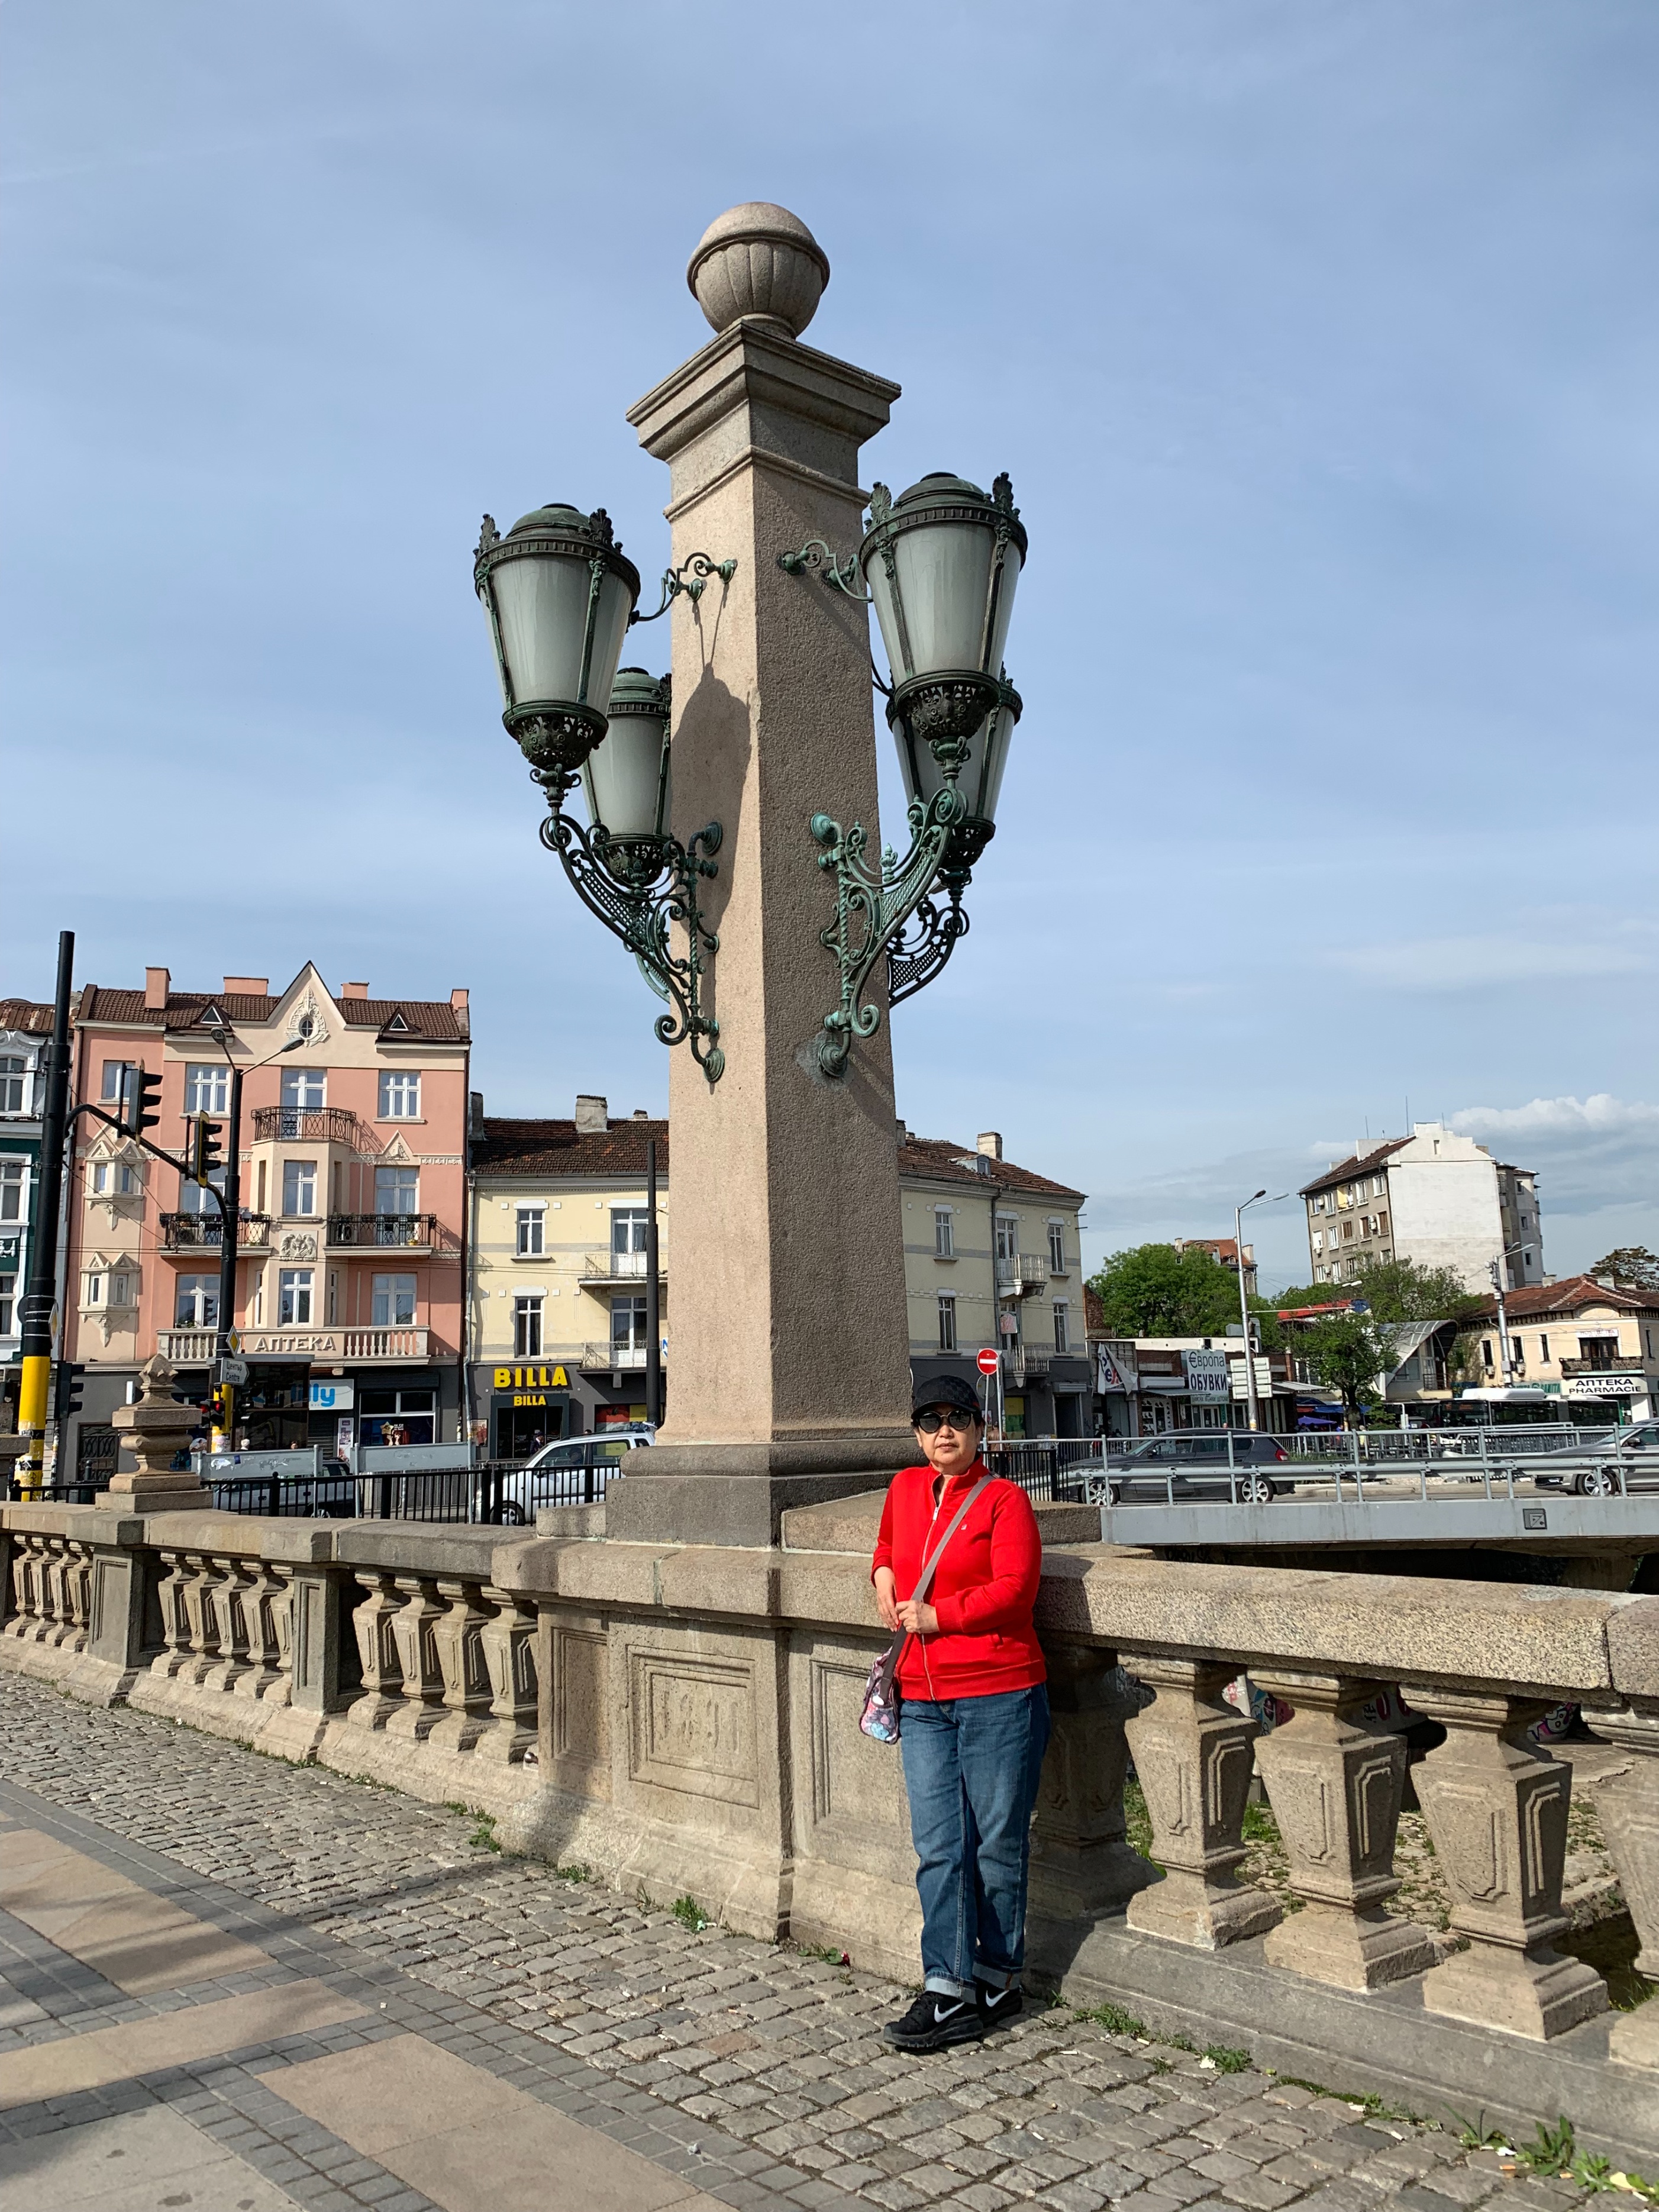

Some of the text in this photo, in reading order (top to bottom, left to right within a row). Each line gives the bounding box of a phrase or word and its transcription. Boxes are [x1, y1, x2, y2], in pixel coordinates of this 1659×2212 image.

[254, 1336, 336, 1352] АПТЕКА
[227, 1360, 243, 1373] Център
[226, 1372, 240, 1382] Centre
[493, 1366, 568, 1388] BILLA
[1190, 1373, 1228, 1391] ОБУВКИ
[1576, 1378, 1633, 1386] АПТЕКА
[1569, 1386, 1641, 1394] PHARMACIE
[514, 1395, 546, 1406] BILLA
